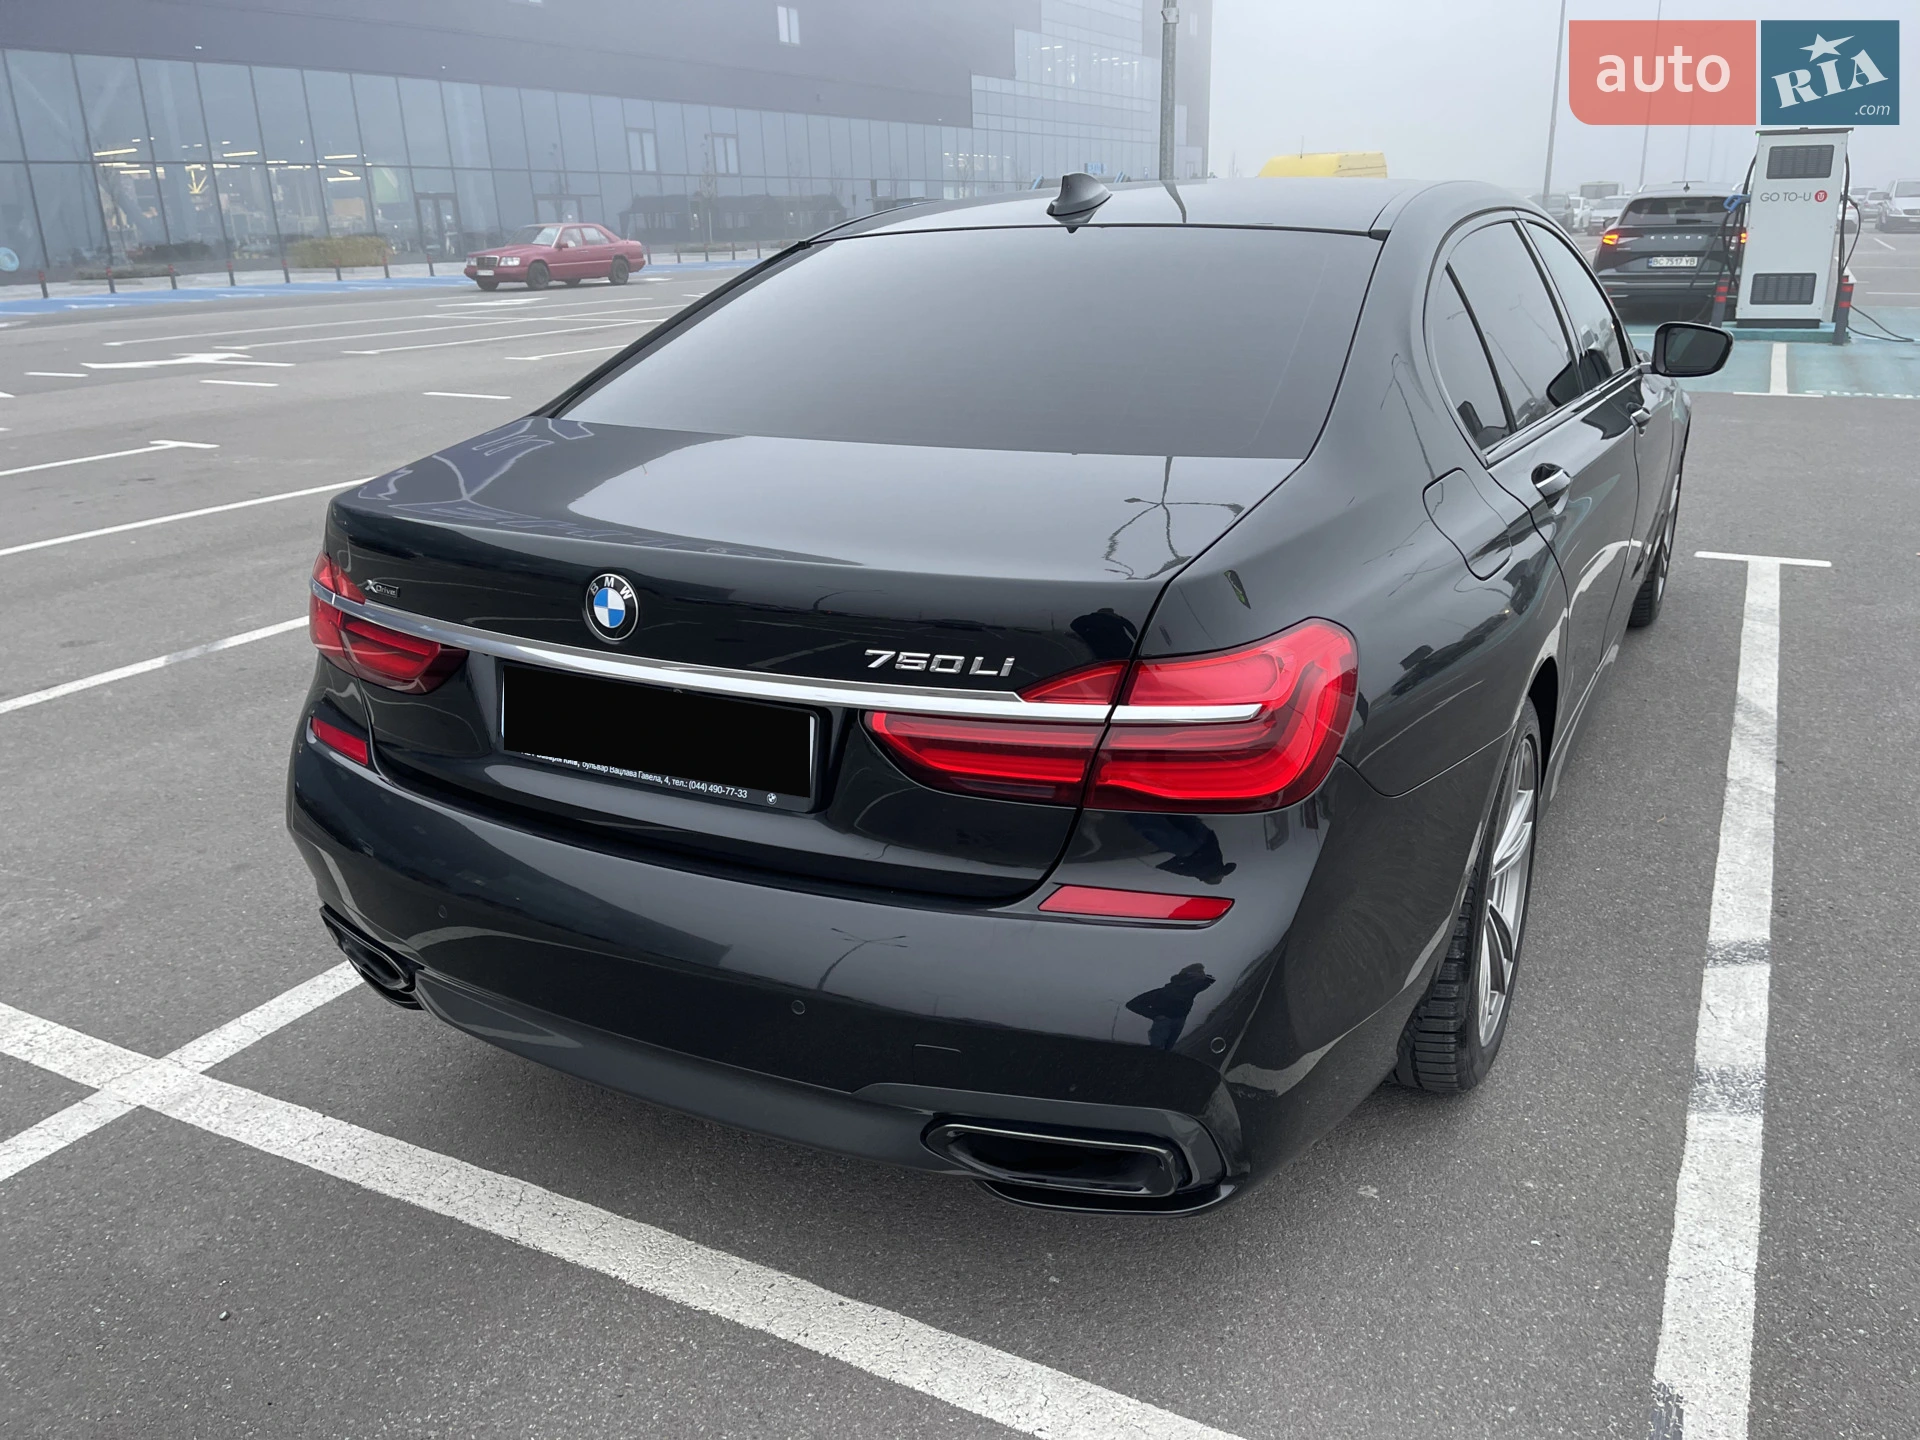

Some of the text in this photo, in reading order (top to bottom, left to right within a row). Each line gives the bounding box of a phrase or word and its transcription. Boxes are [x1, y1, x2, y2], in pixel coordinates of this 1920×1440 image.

[1760, 192, 1780, 202] GO
[1783, 192, 1812, 202] TO-U
[590, 576, 633, 600] BMW
[638, 770, 663, 784] Гавела,
[664, 776, 671, 786] 4,
[688, 780, 708, 793] (044)
[708, 784, 748, 799] 490-77-33
